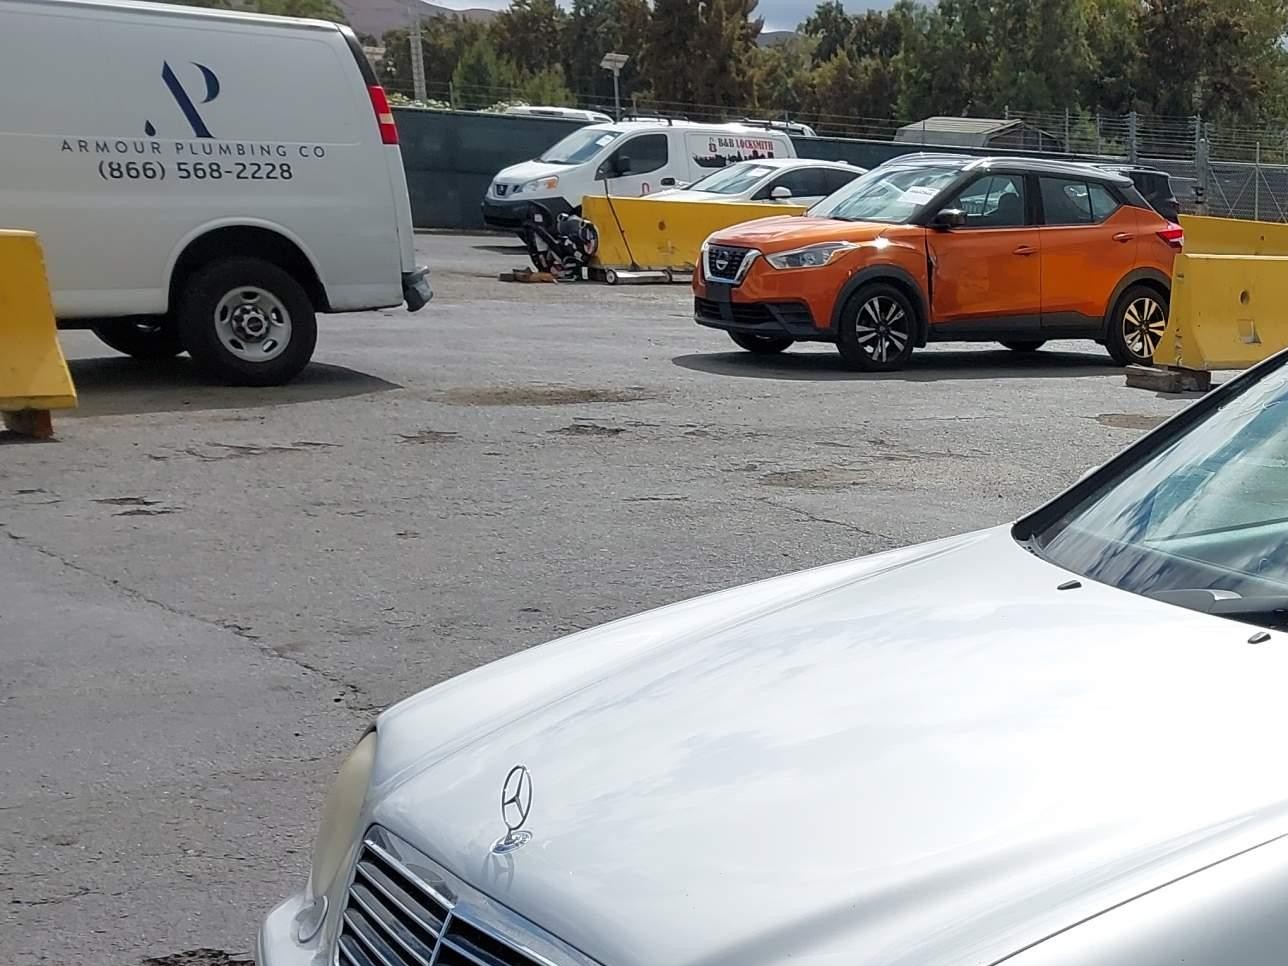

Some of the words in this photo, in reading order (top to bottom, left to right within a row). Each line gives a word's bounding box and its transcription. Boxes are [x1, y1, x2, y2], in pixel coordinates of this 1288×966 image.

[61, 139, 162, 154] ARMOUR
[175, 142, 287, 157] PLUMBING
[298, 145, 325, 158] CO
[735, 139, 774, 151] LOCKSMITH
[98, 160, 166, 180] (866)
[177, 161, 293, 180] 568-2228
